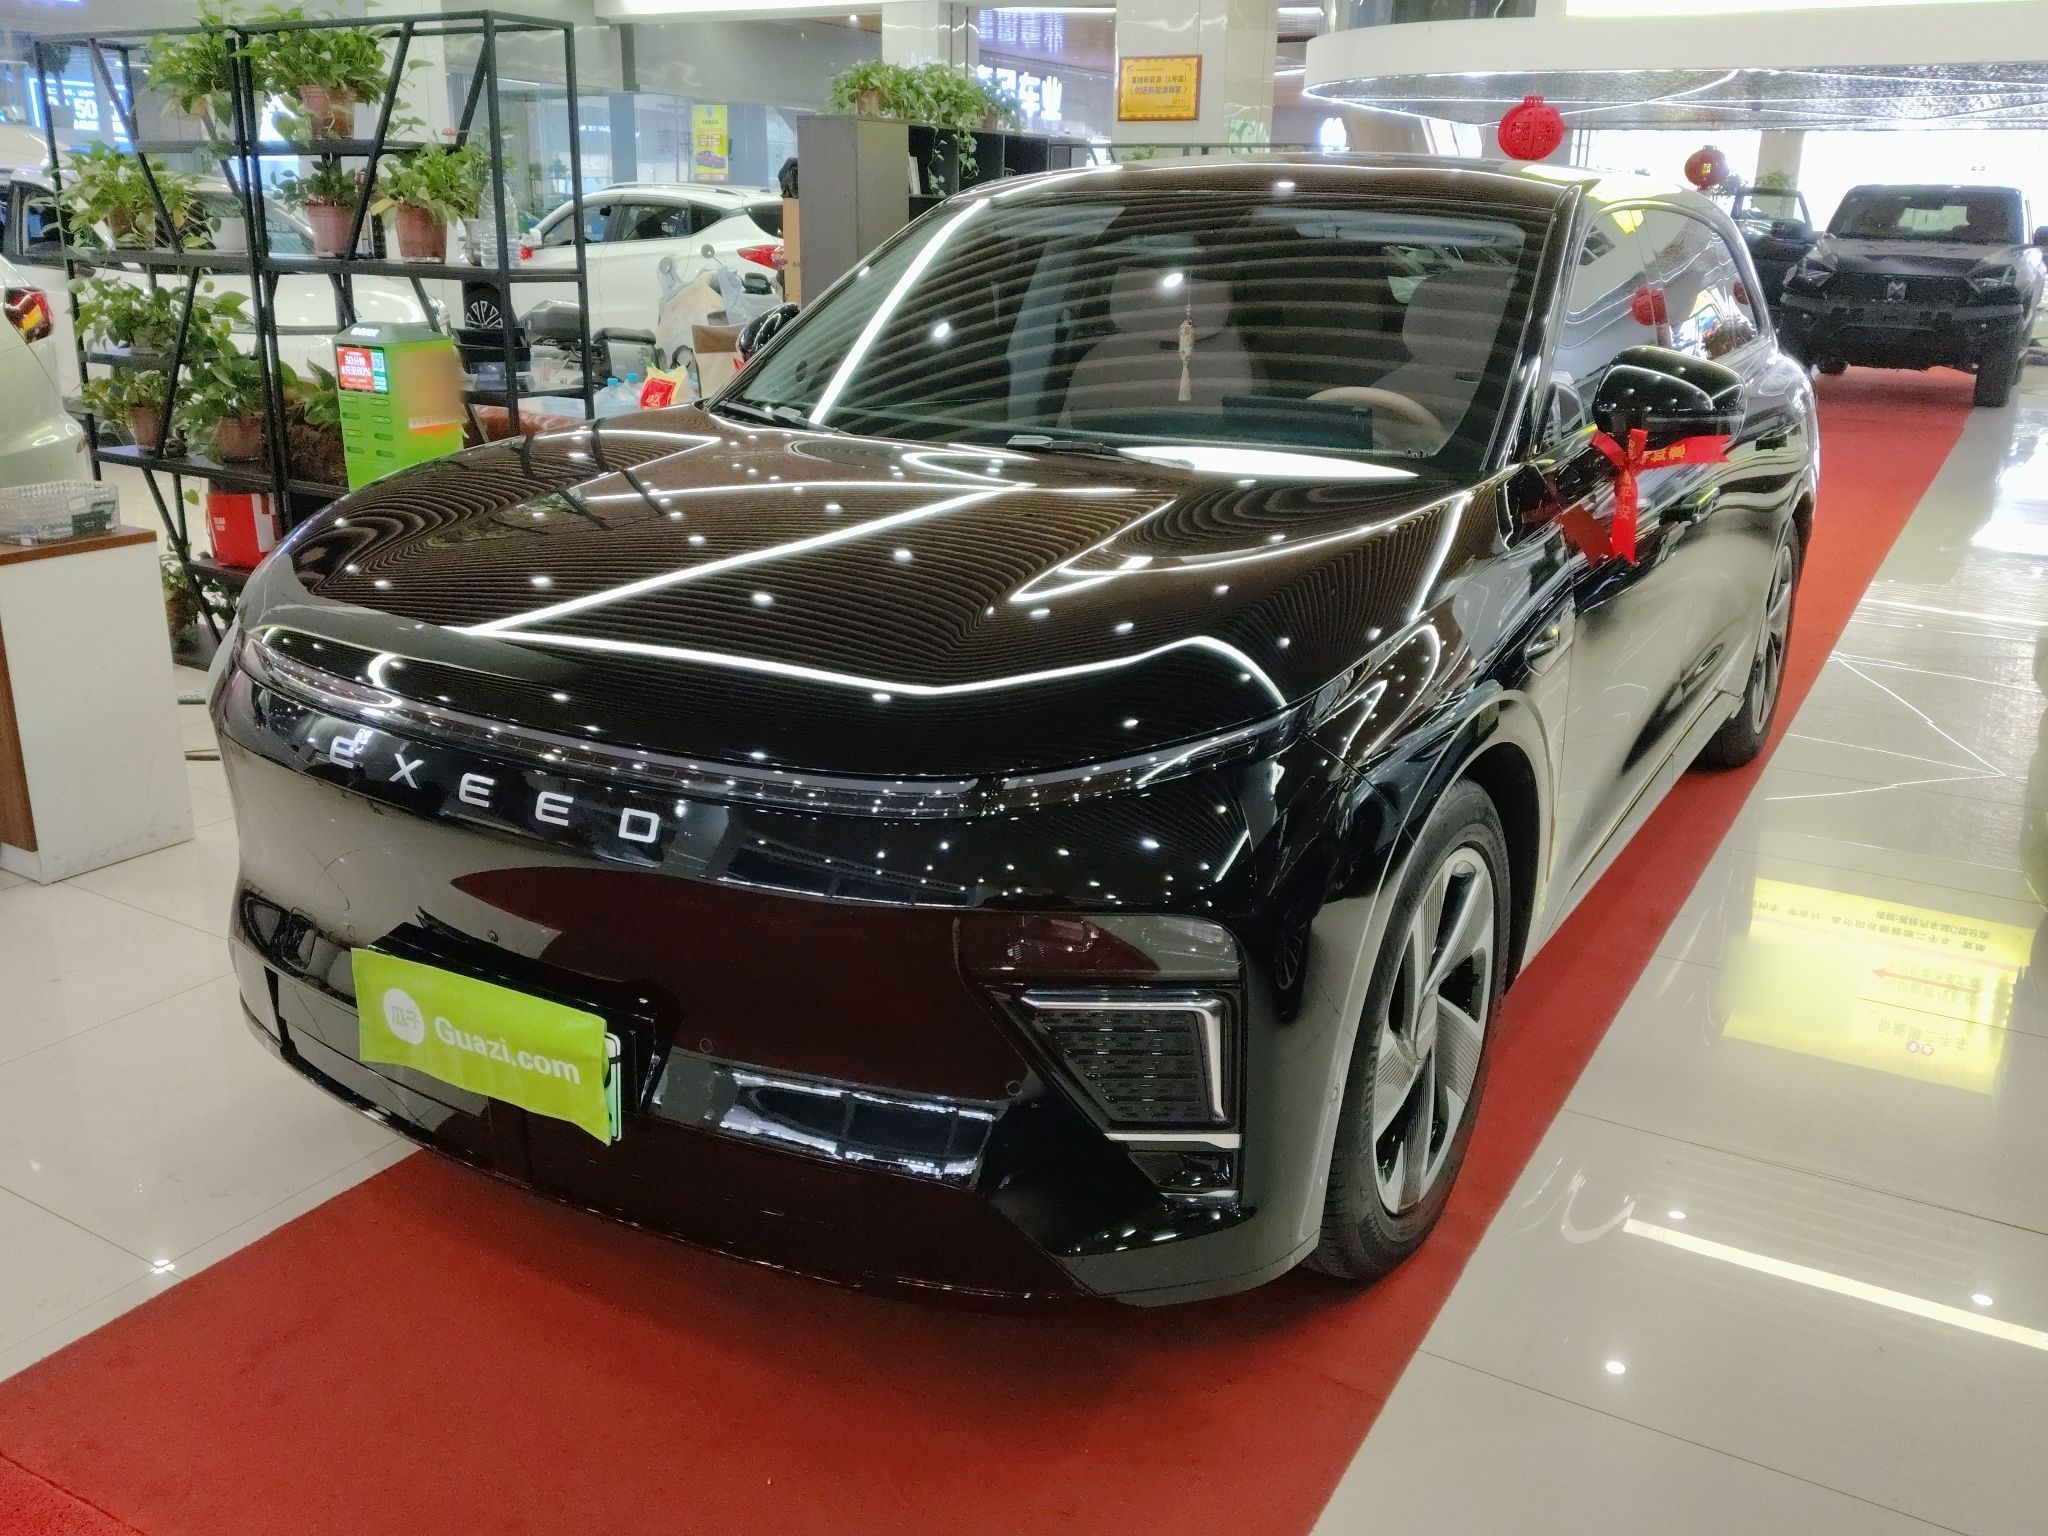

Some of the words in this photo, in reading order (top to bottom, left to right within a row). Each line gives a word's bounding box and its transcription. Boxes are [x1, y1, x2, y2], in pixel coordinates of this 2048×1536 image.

[329, 735, 660, 843] EXEED
[391, 1005, 421, 1029] 瓜子
[434, 1016, 581, 1084] Guazi.com
